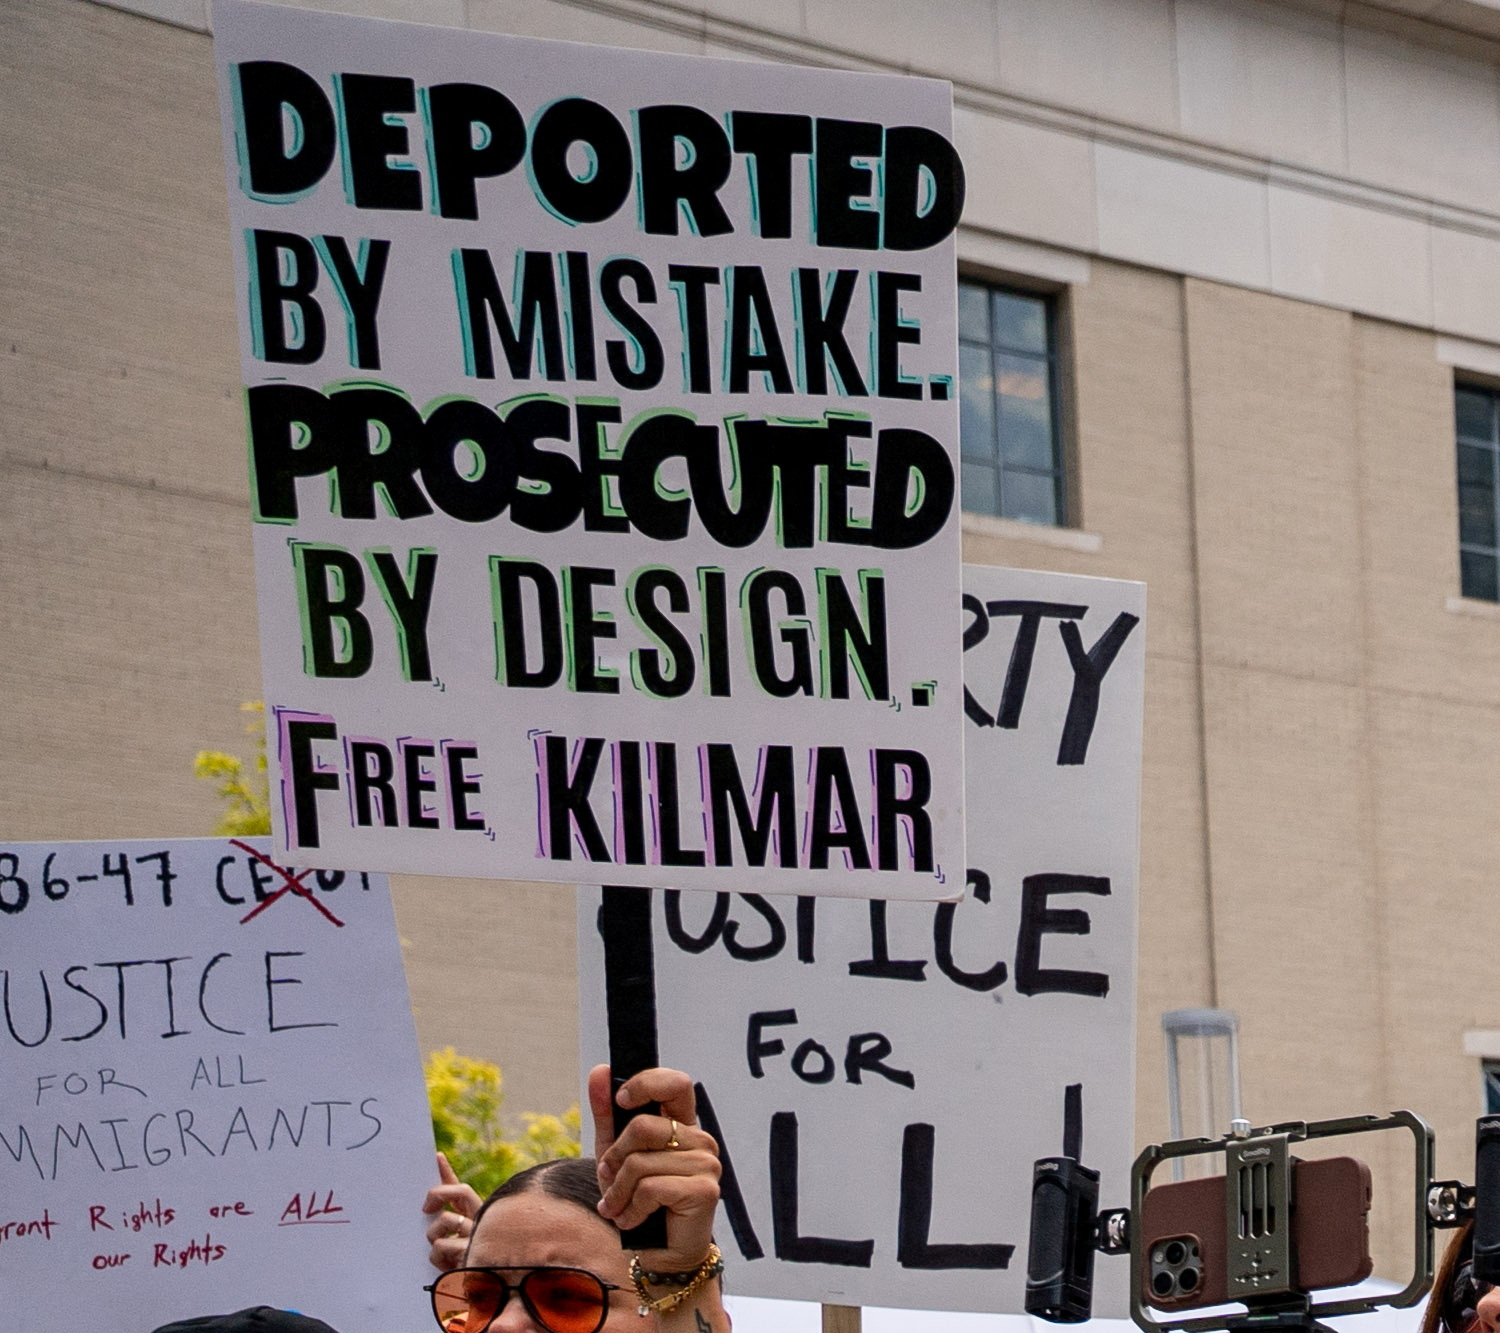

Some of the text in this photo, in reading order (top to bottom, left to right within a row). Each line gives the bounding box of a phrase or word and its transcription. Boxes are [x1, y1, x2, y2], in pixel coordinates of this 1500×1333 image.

[229, 61, 966, 252] DEPORTED
[245, 229, 953, 400] BY MISTAKE.
[246, 380, 956, 551] PROSECUTED
[290, 540, 936, 707] BY DESIGN.
[532, 731, 942, 878] KILMAR
[0, 951, 339, 1047] USTICE
[746, 1007, 915, 1089] FOR
[36, 1054, 268, 1106] FOR ALL
[92, 1233, 228, 1270] our Rights
[209, 1201, 255, 1218] are
[280, 1189, 344, 1221] ALL
